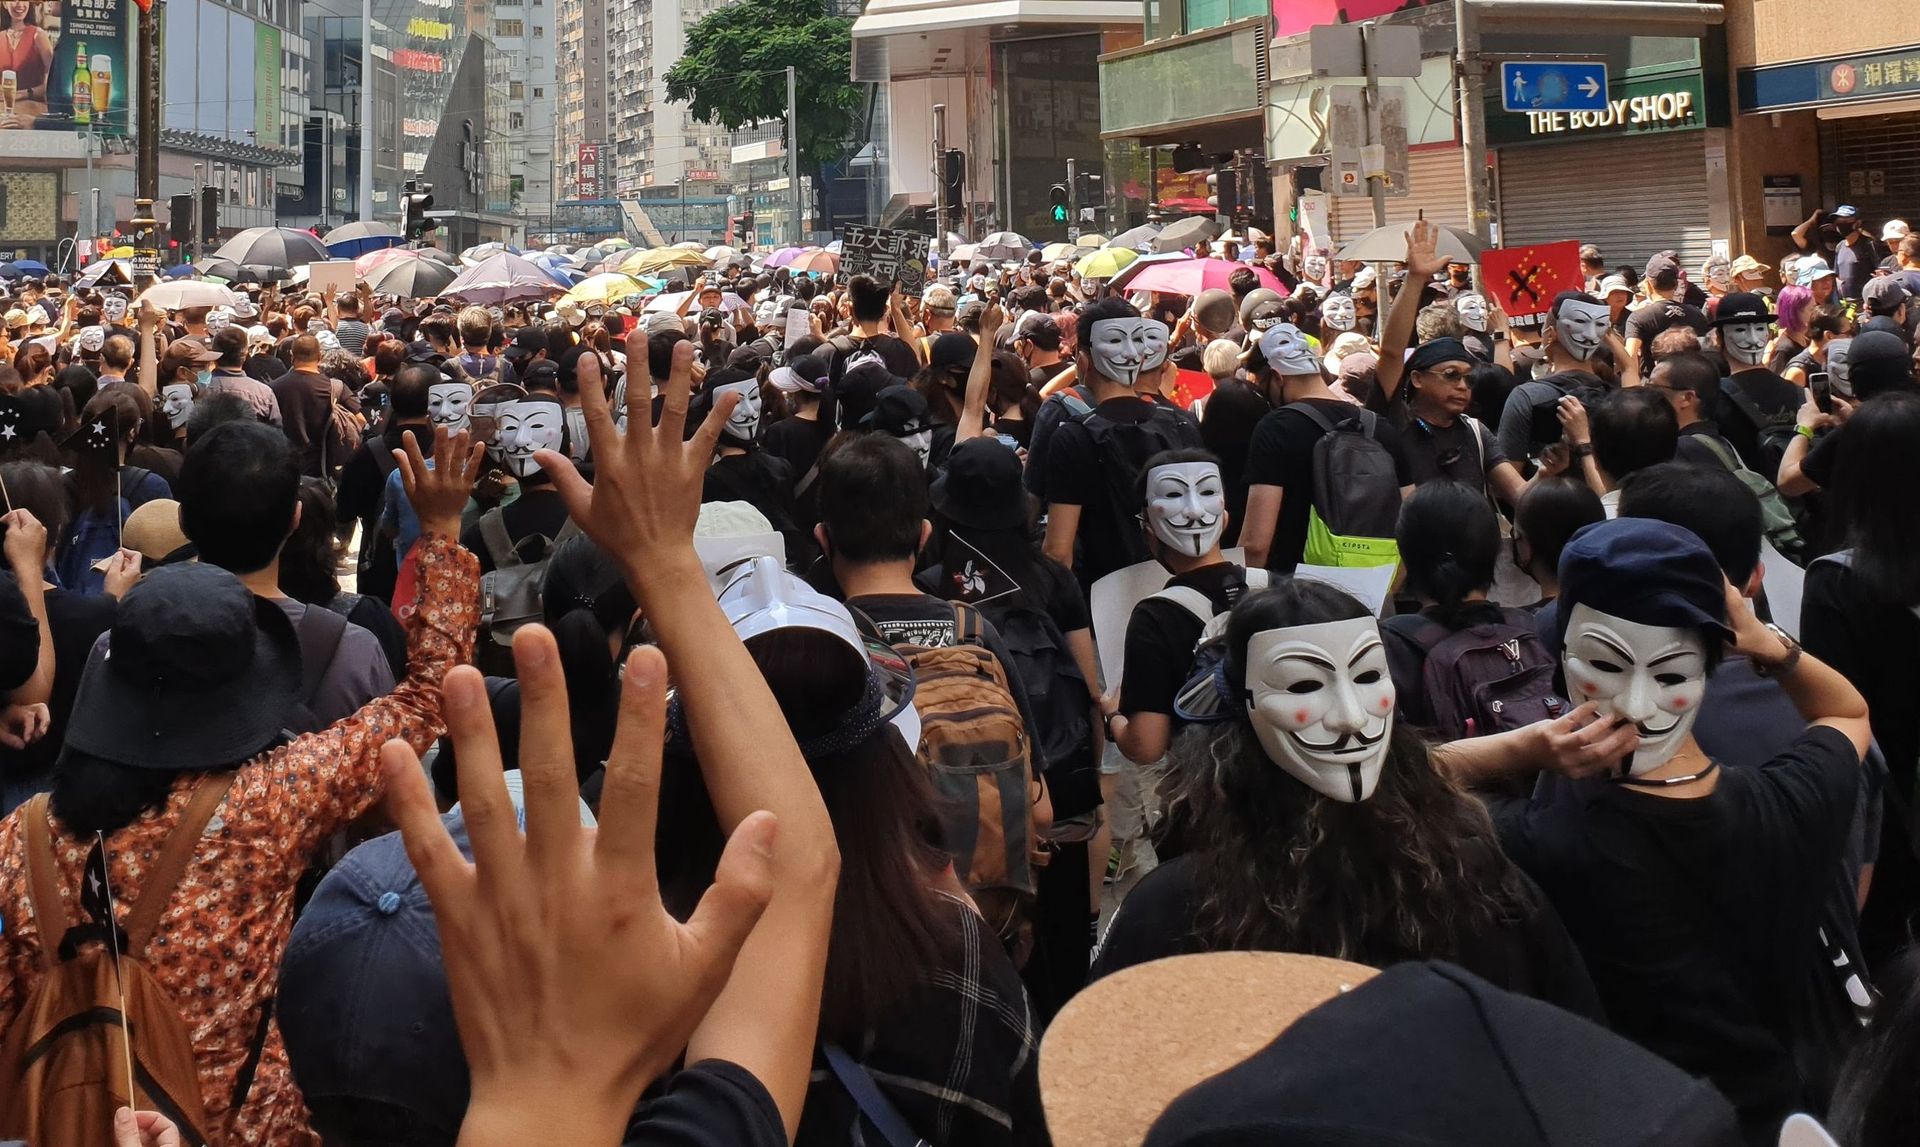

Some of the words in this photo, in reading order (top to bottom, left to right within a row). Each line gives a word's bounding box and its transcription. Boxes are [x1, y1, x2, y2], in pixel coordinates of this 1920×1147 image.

[1526, 110, 1566, 134] THE
[1569, 98, 1630, 130] BODY
[844, 227, 929, 259] 五大訴求
